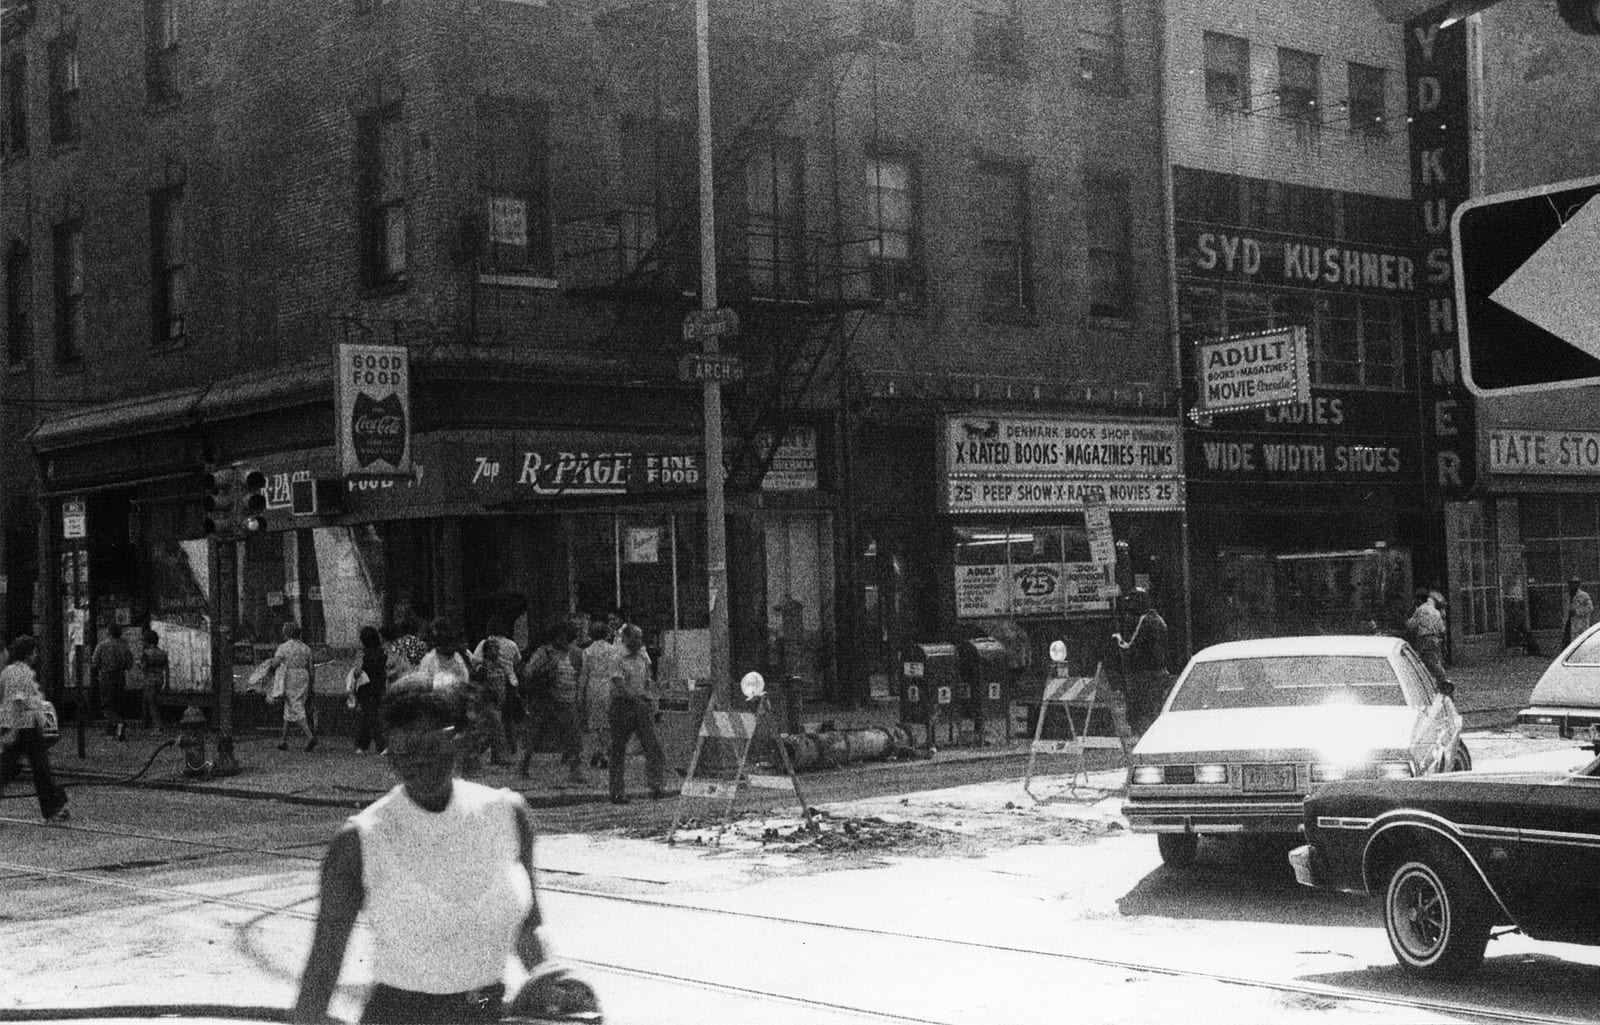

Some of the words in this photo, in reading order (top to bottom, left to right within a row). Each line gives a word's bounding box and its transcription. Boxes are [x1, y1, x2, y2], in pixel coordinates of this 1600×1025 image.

[1414, 24, 1441, 112] YD
[1198, 232, 1262, 275] SYD
[1283, 242, 1415, 291] KUSHNER
[353, 355, 401, 370] GOOD
[1208, 340, 1286, 370] ADULT
[353, 371, 400, 385] FOOD
[695, 362, 731, 380] ARCH
[1208, 370, 1236, 382] BOOKS
[1240, 362, 1289, 377] MAGAZINES
[1208, 380, 1256, 401] MOVIE
[1264, 397, 1344, 424] LADIES
[1006, 424, 1058, 440] DENMARK
[1064, 426, 1096, 441] BOOK
[1101, 426, 1129, 441] SHOP
[647, 456, 697, 469] FINE
[1015, 443, 1058, 465] BOOKS
[1065, 444, 1134, 466] MAGAZINES
[1140, 445, 1173, 466] FILMS
[1202, 442, 1255, 471] WIDE
[1262, 444, 1326, 472] WIDTH
[1334, 446, 1400, 472] SHOES
[647, 469, 698, 483] FOOD
[982, 486, 1012, 500] PEEP
[1017, 485, 1055, 501] SHOW
[1109, 486, 1151, 502] MOVIES
[1026, 579, 1048, 596] 25
